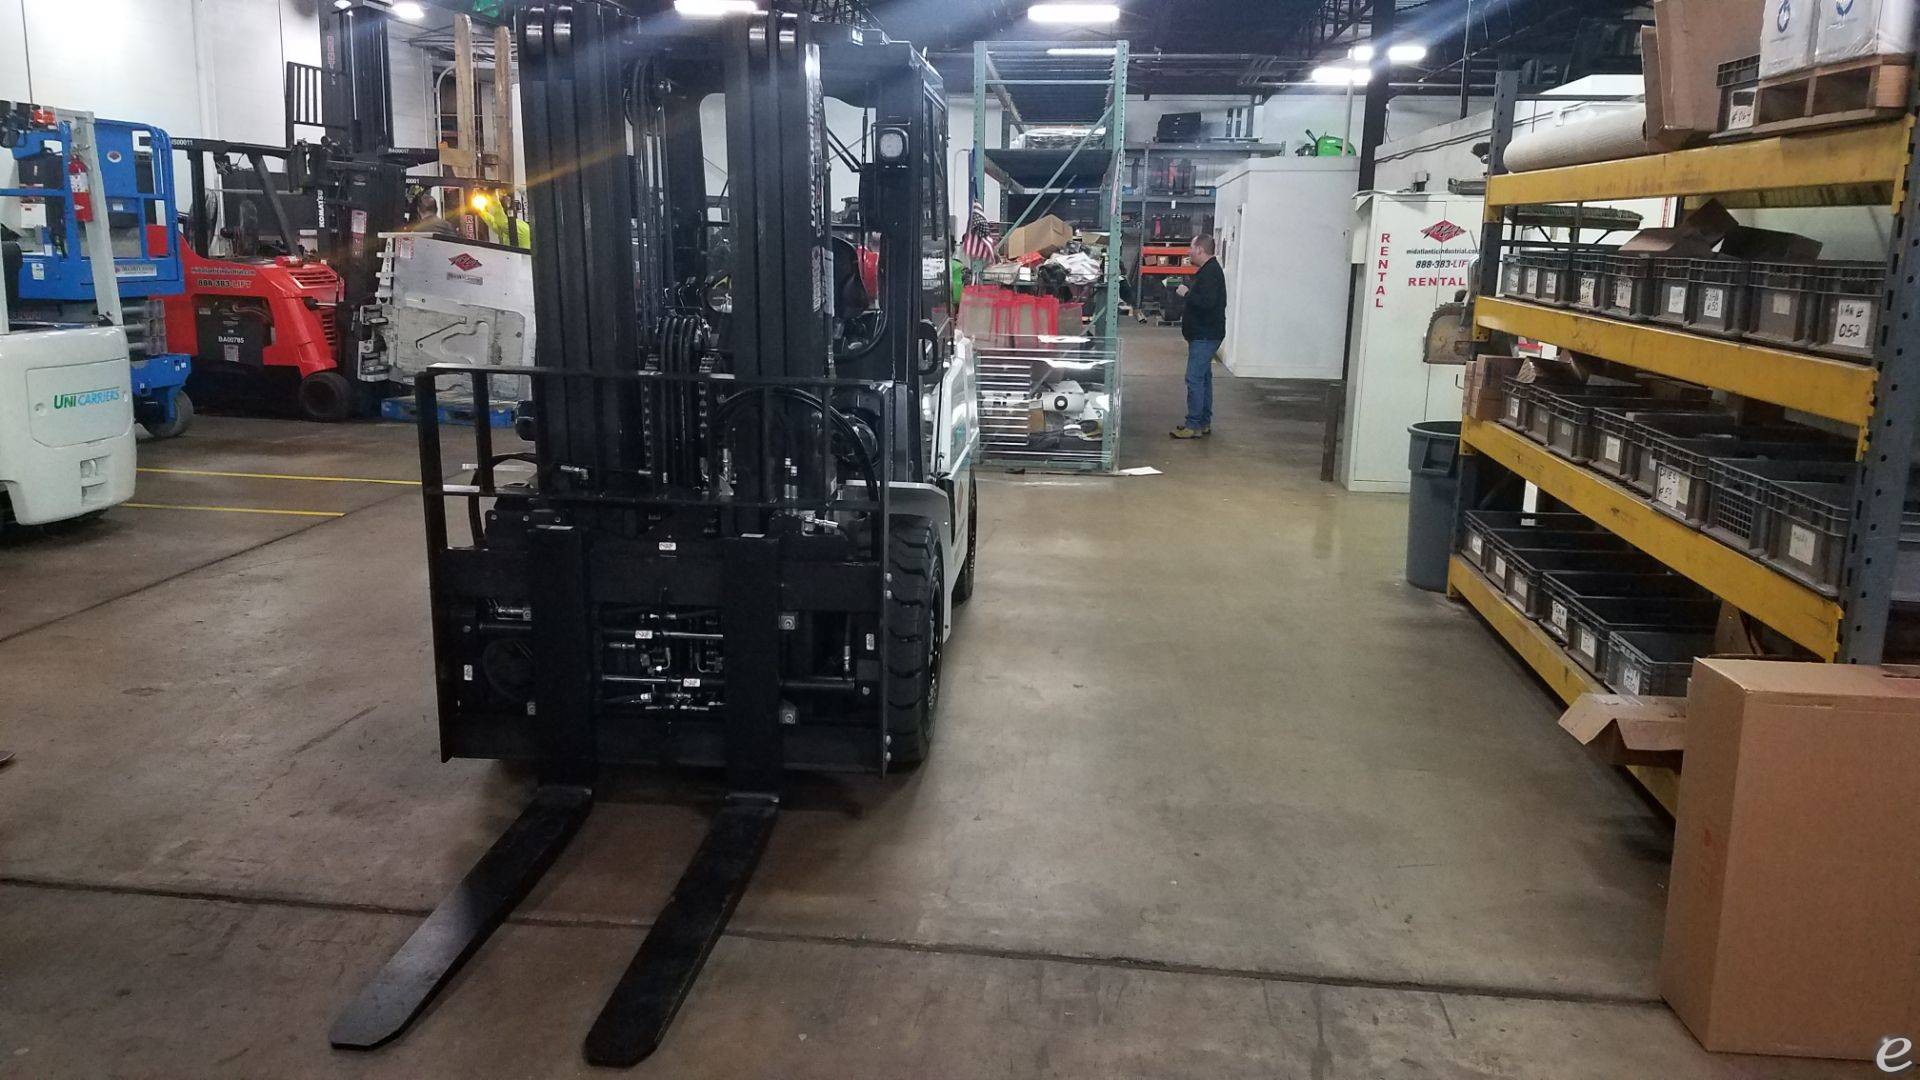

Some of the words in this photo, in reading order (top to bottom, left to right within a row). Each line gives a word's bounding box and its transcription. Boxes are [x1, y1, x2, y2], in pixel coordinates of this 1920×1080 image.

[317, 189, 325, 228] KOMATSU
[1376, 233, 1391, 308] RENTAL
[1415, 259, 1468, 269] 888-383-LIF
[1408, 277, 1466, 287] RENTAL
